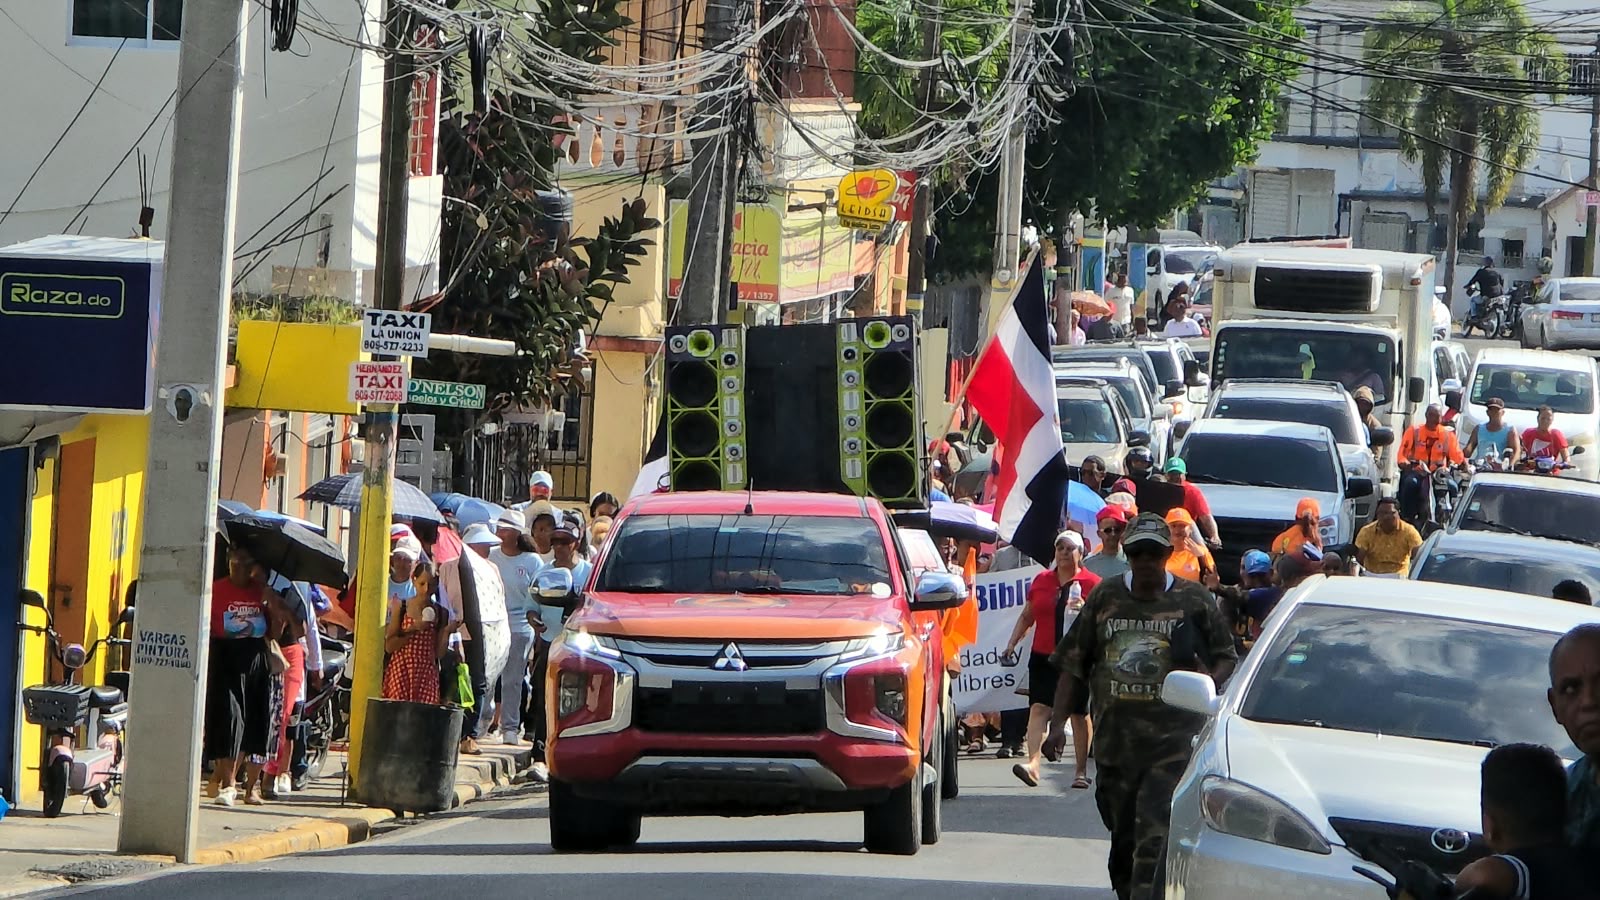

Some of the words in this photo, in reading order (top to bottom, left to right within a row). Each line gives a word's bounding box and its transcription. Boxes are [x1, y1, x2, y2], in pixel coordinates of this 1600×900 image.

[841, 204, 886, 217] LEIDSA
[11, 283, 111, 306] Raza.do
[366, 312, 426, 329] TAXI
[371, 329, 385, 338] LA
[387, 330, 421, 340] UNION
[363, 340, 424, 352] 809-577-2233
[356, 364, 402, 373] HERNANDEZ
[355, 375, 403, 389] TAXI
[140, 630, 187, 645] VARGAS
[137, 644, 189, 659] PINTURA
[958, 672, 1016, 692] libres
